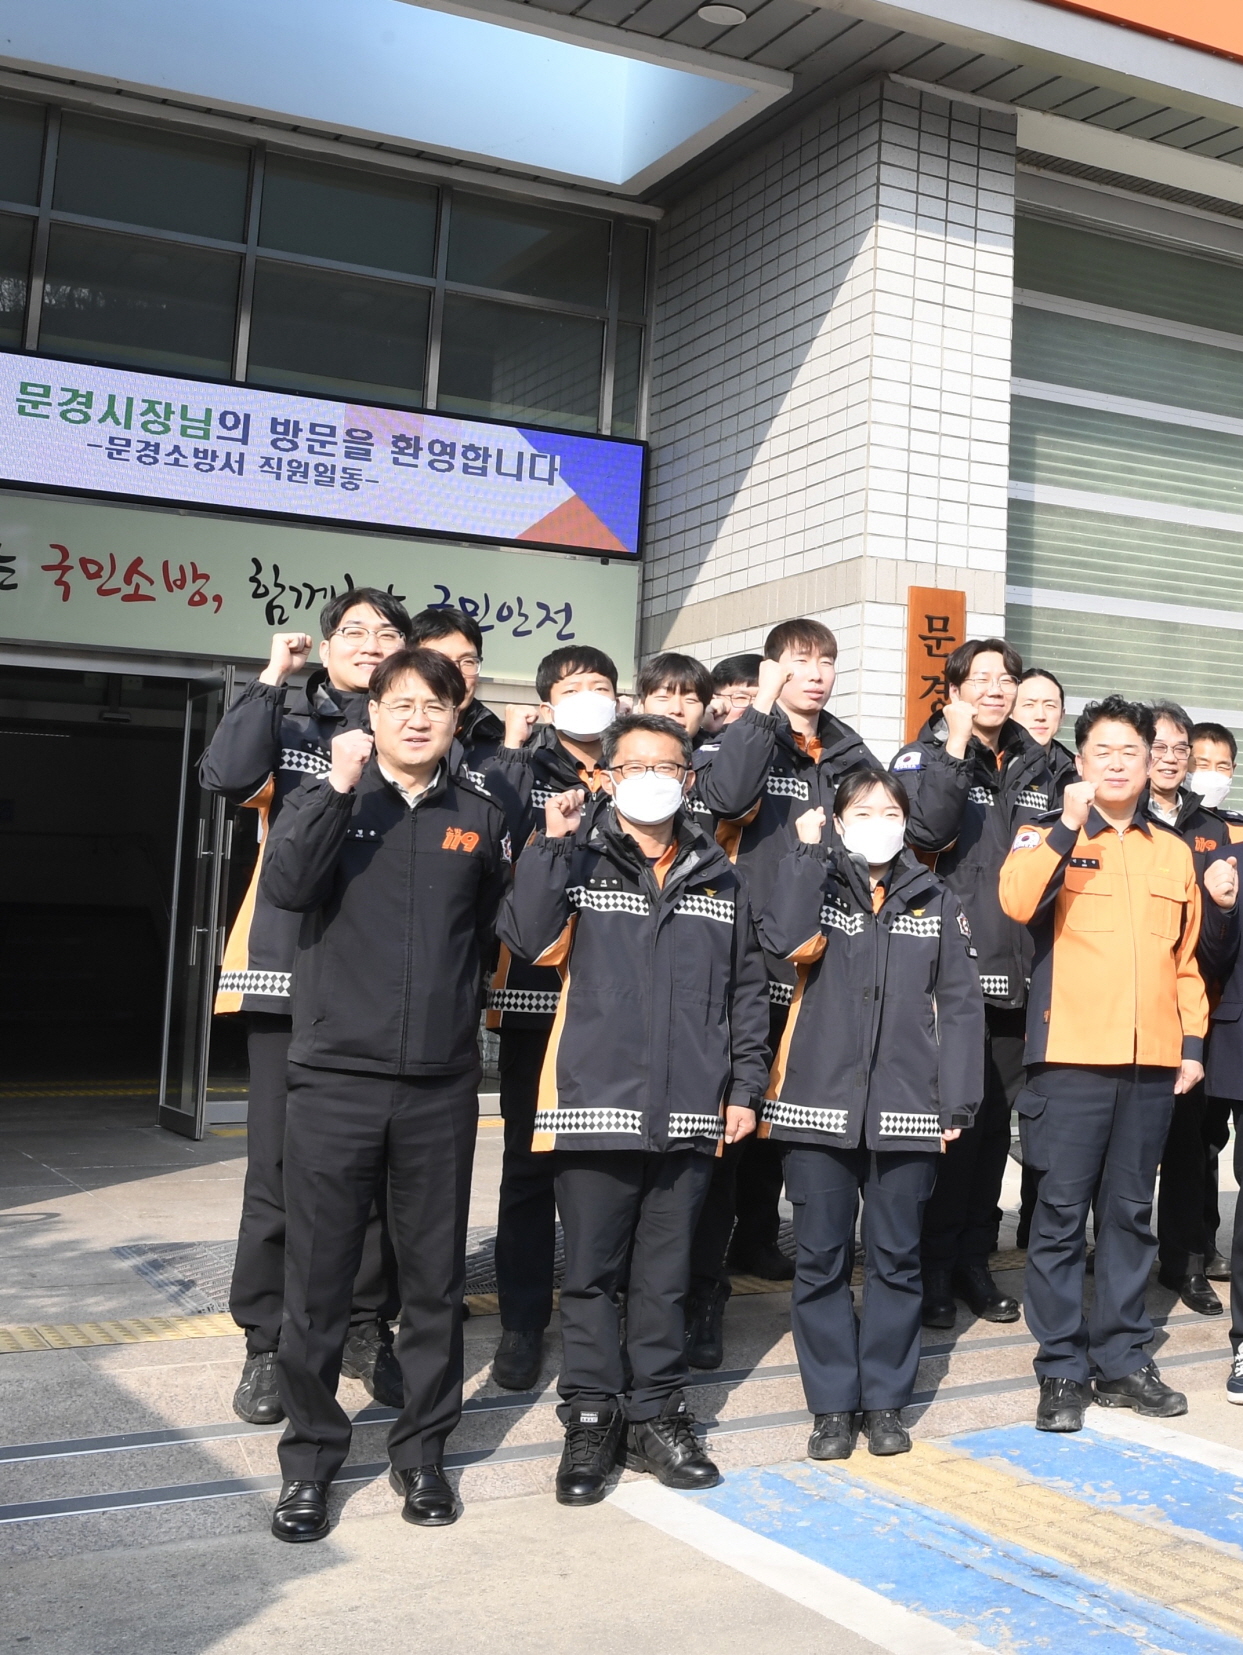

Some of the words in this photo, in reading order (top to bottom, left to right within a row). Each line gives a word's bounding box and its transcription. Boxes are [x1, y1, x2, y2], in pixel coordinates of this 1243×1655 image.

[16, 382, 251, 445] 문경시장님의
[270, 417, 374, 462] 방문을
[391, 434, 561, 486] 환영합니다
[87, 436, 245, 476] -문경소방서
[258, 456, 379, 491] 직원일동-
[41, 543, 223, 614] 국민소방,
[441, 831, 479, 853] 119
